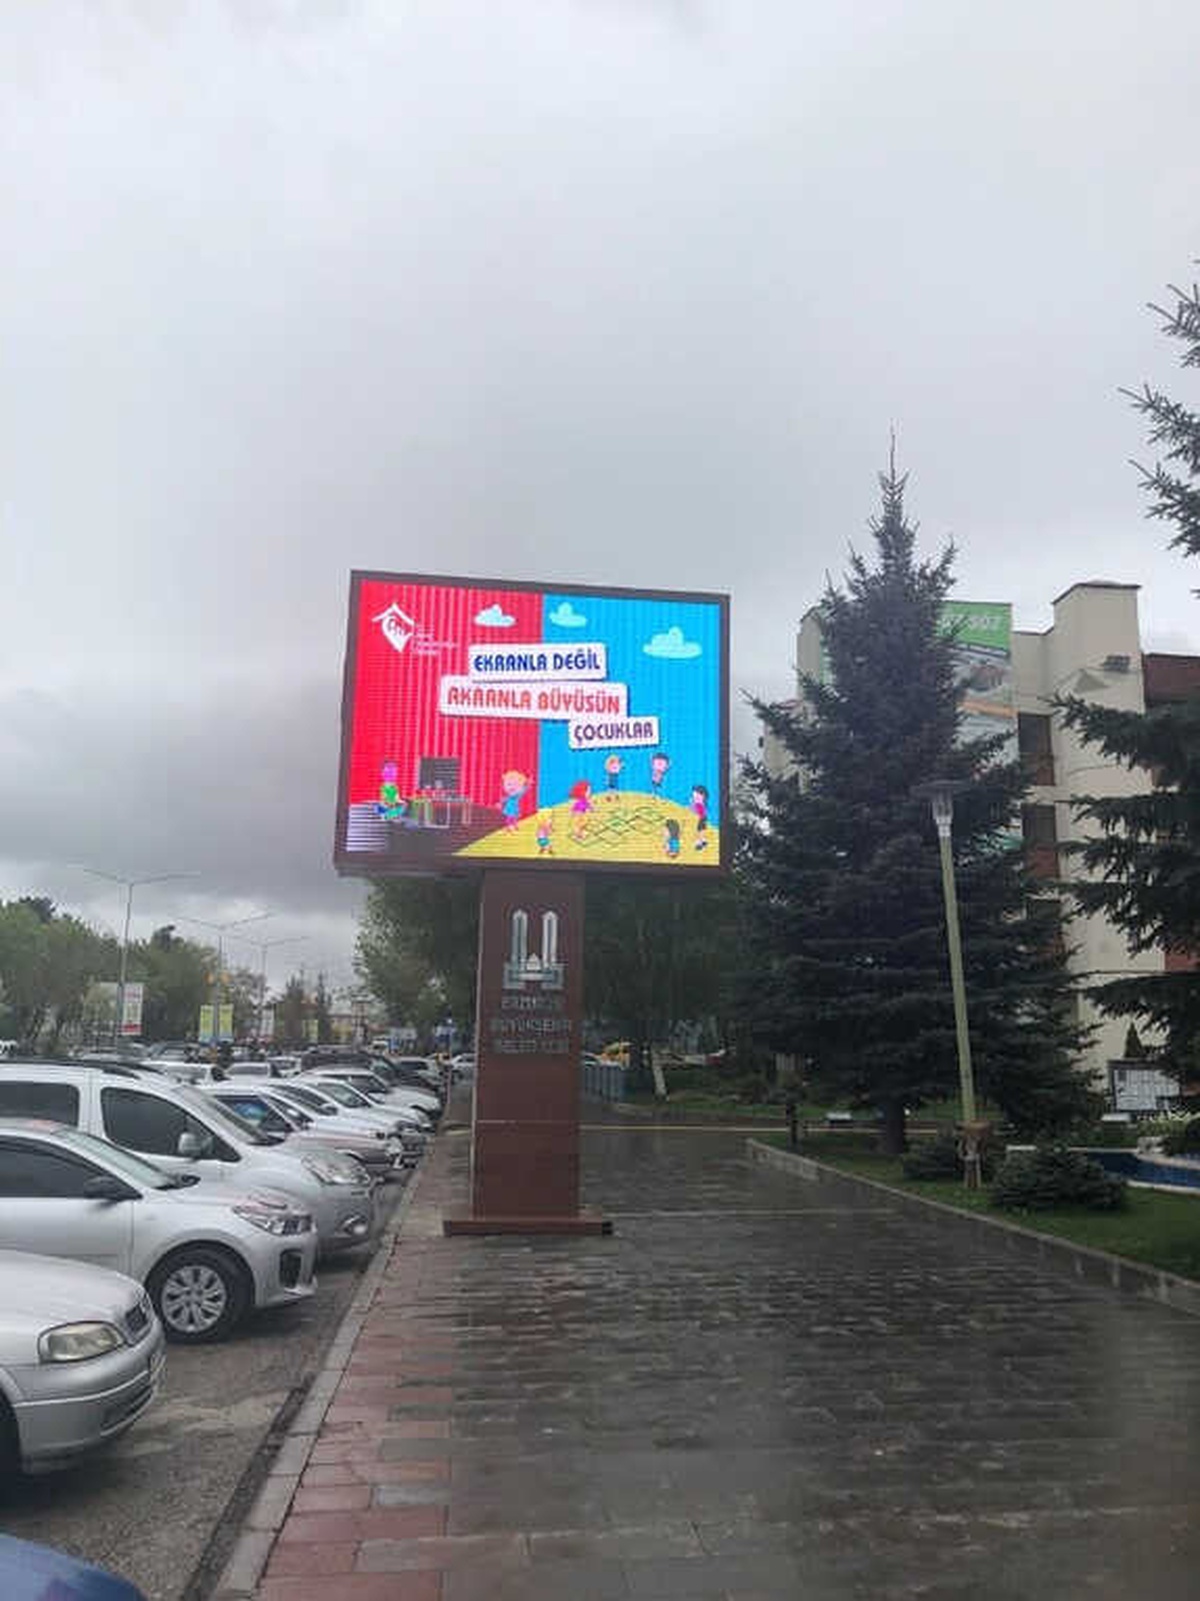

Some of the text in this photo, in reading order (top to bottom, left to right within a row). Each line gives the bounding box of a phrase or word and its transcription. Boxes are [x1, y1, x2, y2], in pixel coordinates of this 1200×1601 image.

[474, 648, 600, 671] EKRANLA DEĞİL
[538, 689, 620, 714] BÜYÜSÜN
[574, 722, 653, 743] ÇOCUKLAR
